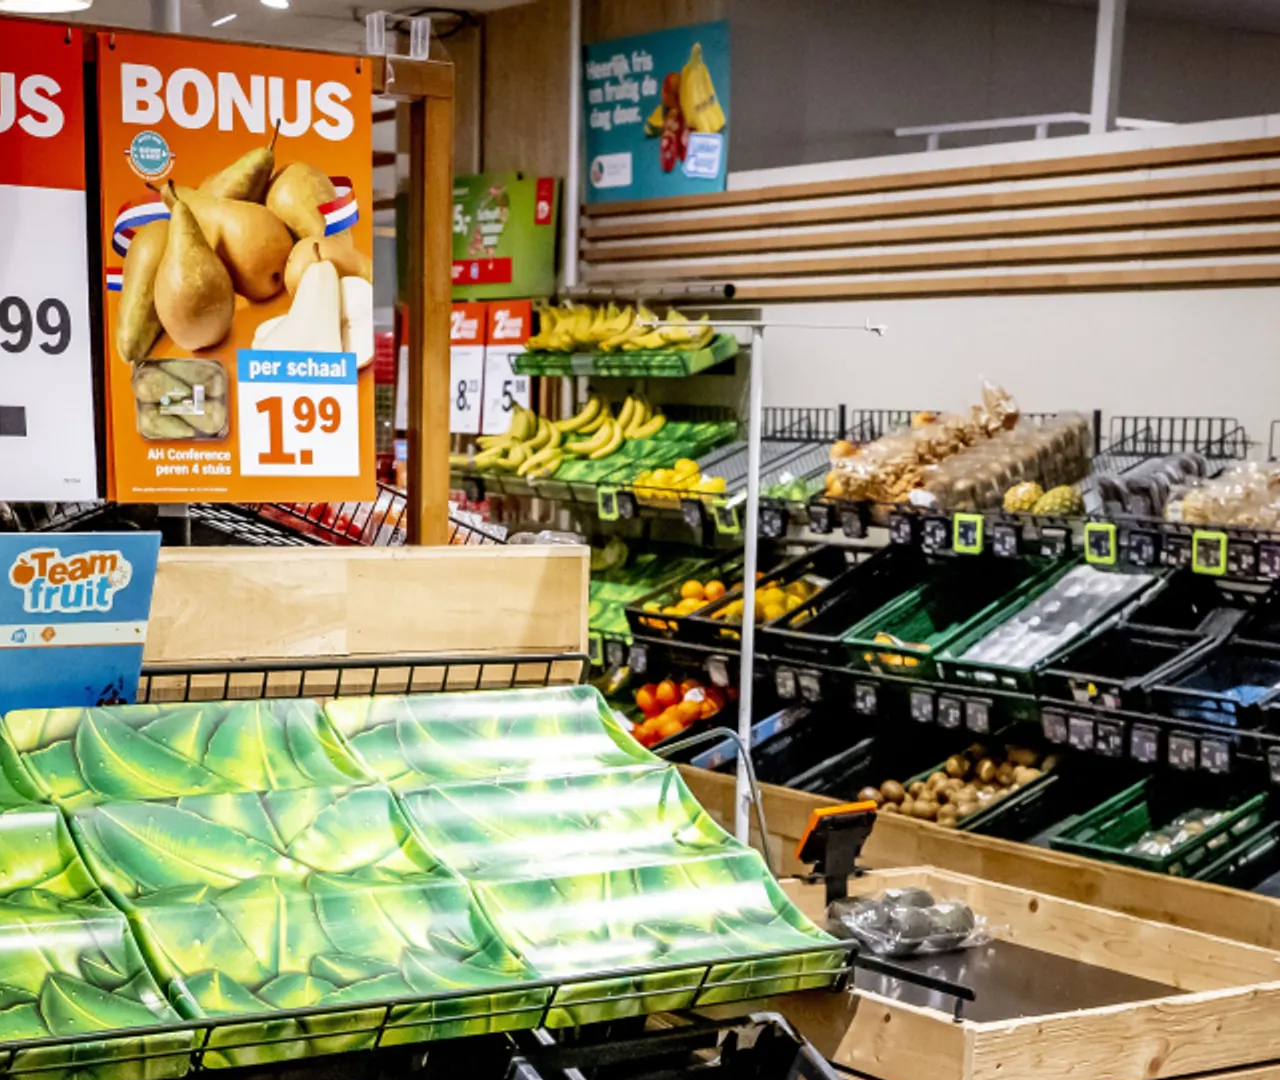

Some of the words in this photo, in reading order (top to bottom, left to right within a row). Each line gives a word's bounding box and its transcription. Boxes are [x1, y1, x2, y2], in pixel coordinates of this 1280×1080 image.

[120, 63, 355, 141] BONUS
[249, 359, 281, 379] per
[287, 359, 347, 377] schaal
[256, 396, 342, 465] 1.99
[147, 448, 165, 460] AH
[167, 449, 231, 461] Conference
[156, 464, 189, 477] peren
[191, 464, 200, 475] 4
[202, 464, 232, 475] stuks
[30, 551, 117, 585] Team
[30, 577, 112, 609] fruit
